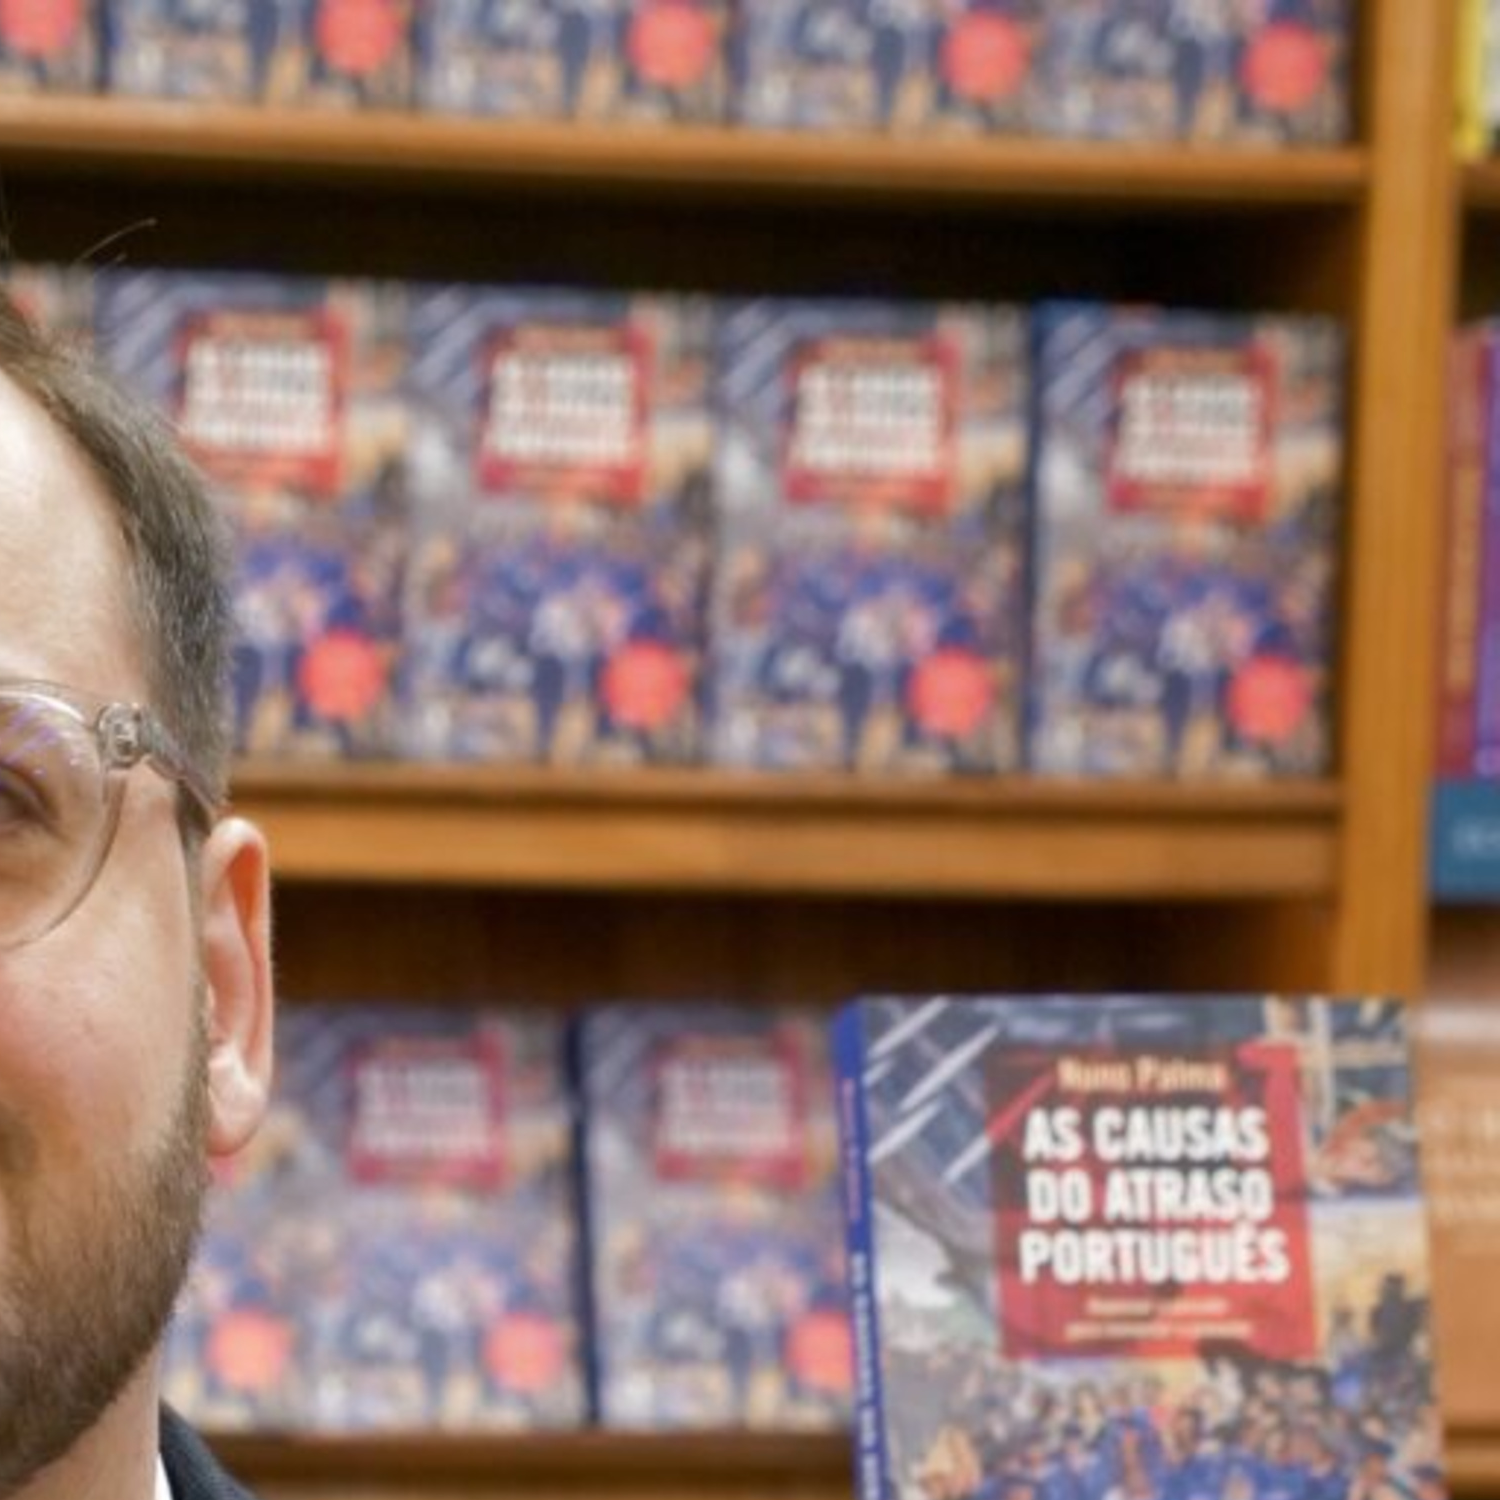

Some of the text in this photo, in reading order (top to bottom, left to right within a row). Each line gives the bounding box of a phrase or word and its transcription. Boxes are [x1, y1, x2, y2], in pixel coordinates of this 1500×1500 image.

[1057, 1055, 1229, 1092] Nuno Palma
[1023, 1104, 1270, 1162] AS CAUSAS
[1026, 1167, 1274, 1223] DO ATRASO
[1019, 1219, 1291, 1285] PORTUGUÊS
